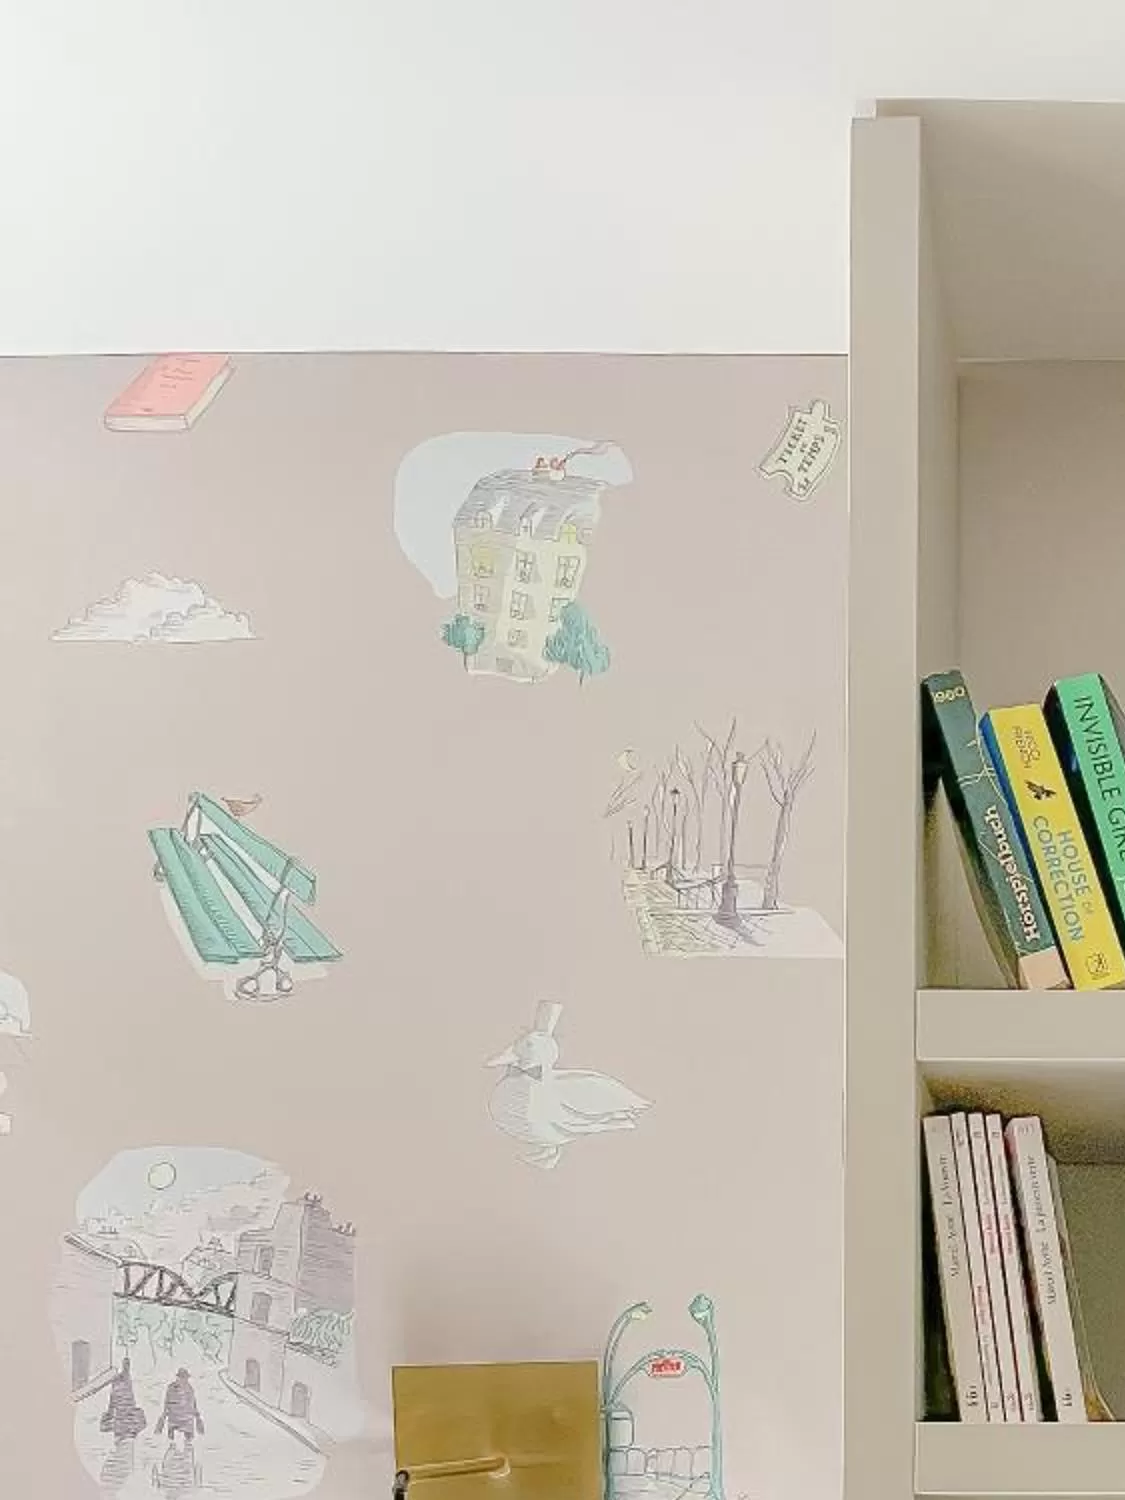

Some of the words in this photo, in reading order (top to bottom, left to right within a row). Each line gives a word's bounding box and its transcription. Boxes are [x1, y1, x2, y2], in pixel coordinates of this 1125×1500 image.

[1073, 696, 1121, 799] INVISIBLE
[984, 805, 1040, 942] Hörspielbuch
[1033, 814, 1084, 941] CORRECTION
[1056, 830, 1091, 897] HOUSE
